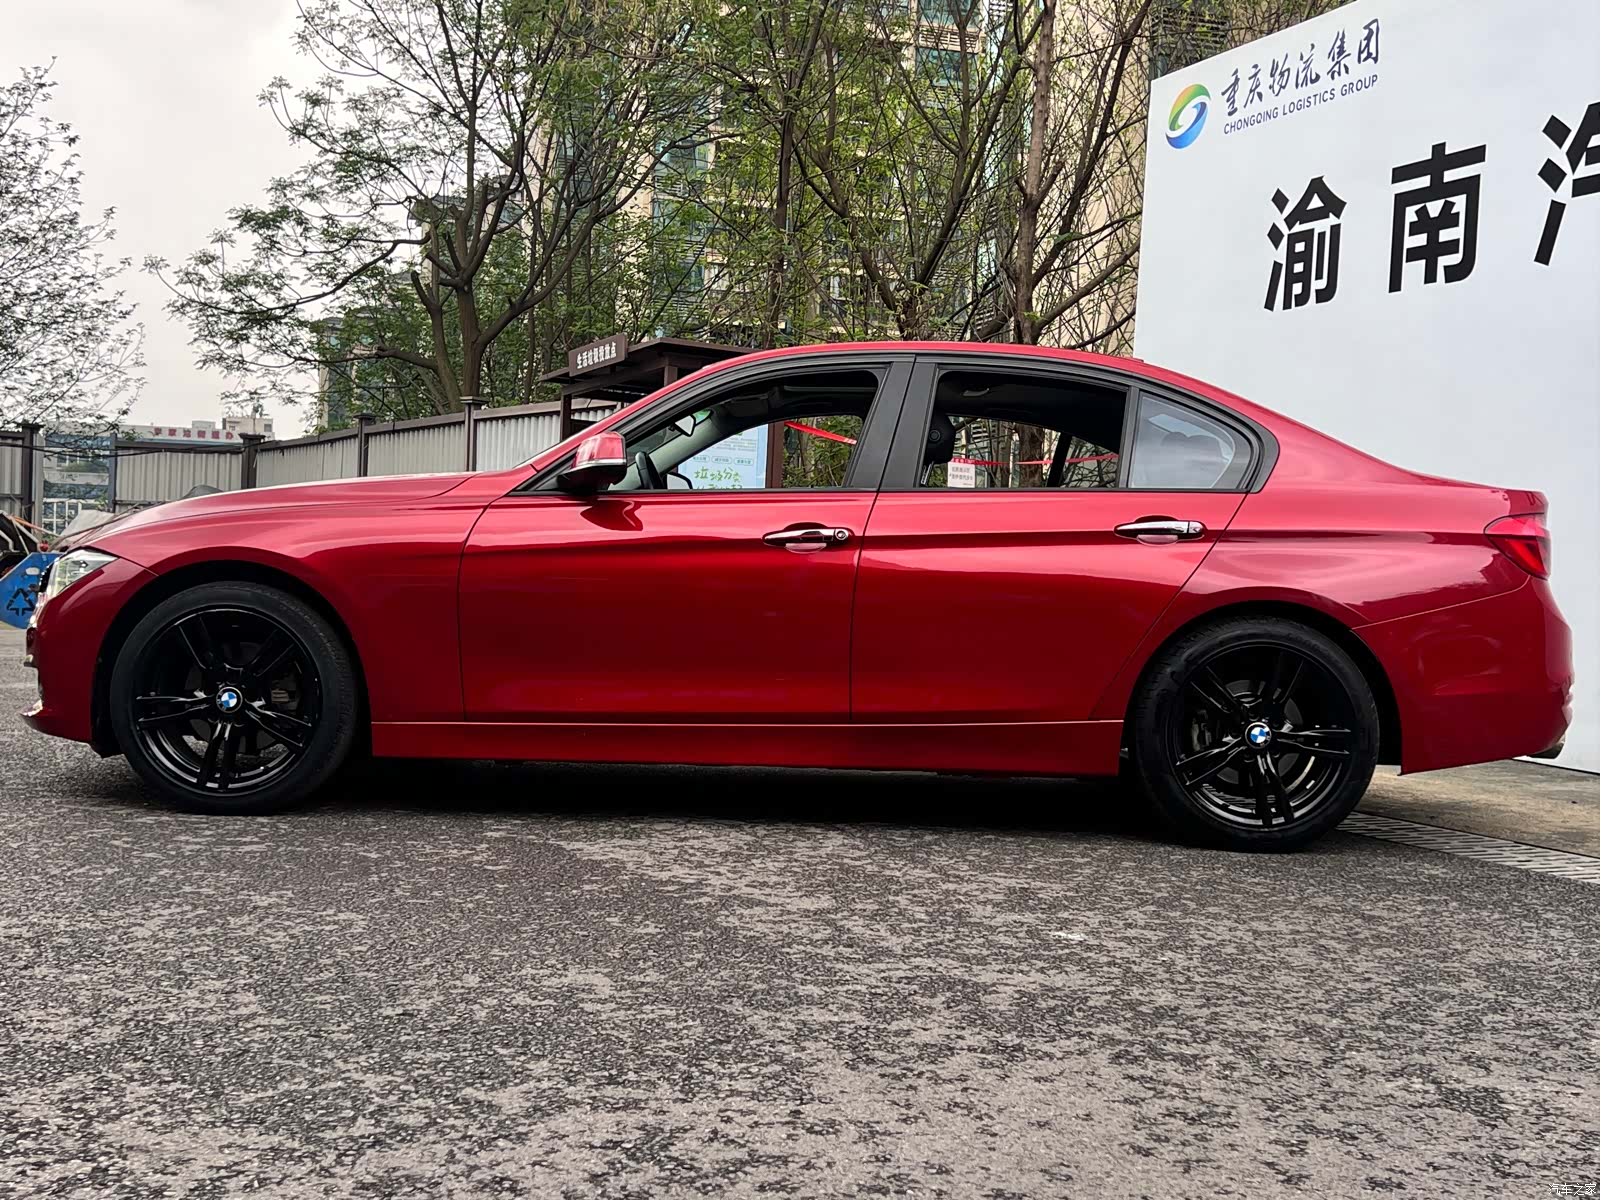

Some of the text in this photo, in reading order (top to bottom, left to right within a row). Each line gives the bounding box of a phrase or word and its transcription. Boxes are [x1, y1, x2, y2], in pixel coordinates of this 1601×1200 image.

[1221, 18, 1380, 118] 重庆物流集团
[1223, 74, 1379, 135] CHONGQING LOGISTICS GROUP
